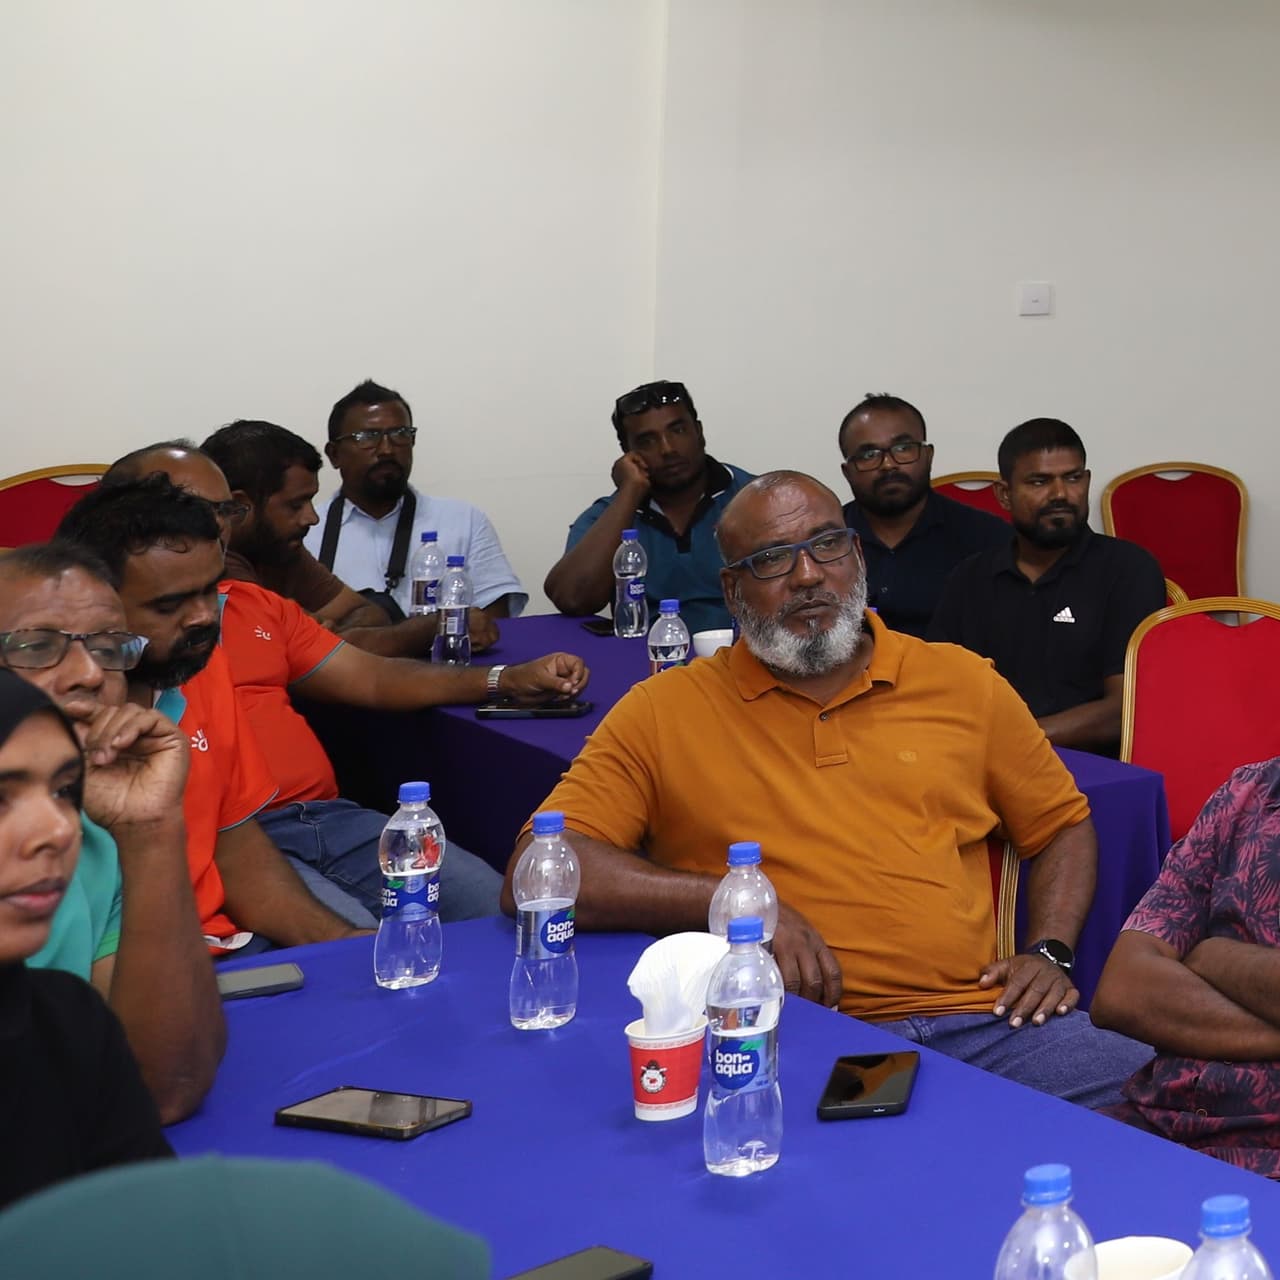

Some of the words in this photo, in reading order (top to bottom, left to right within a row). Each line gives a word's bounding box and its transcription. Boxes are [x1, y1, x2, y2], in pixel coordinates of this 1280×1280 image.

[547, 920, 575, 934] bon-
[547, 928, 575, 943] aqua
[715, 1049, 751, 1064] bon-
[715, 1062, 754, 1078] aqua
